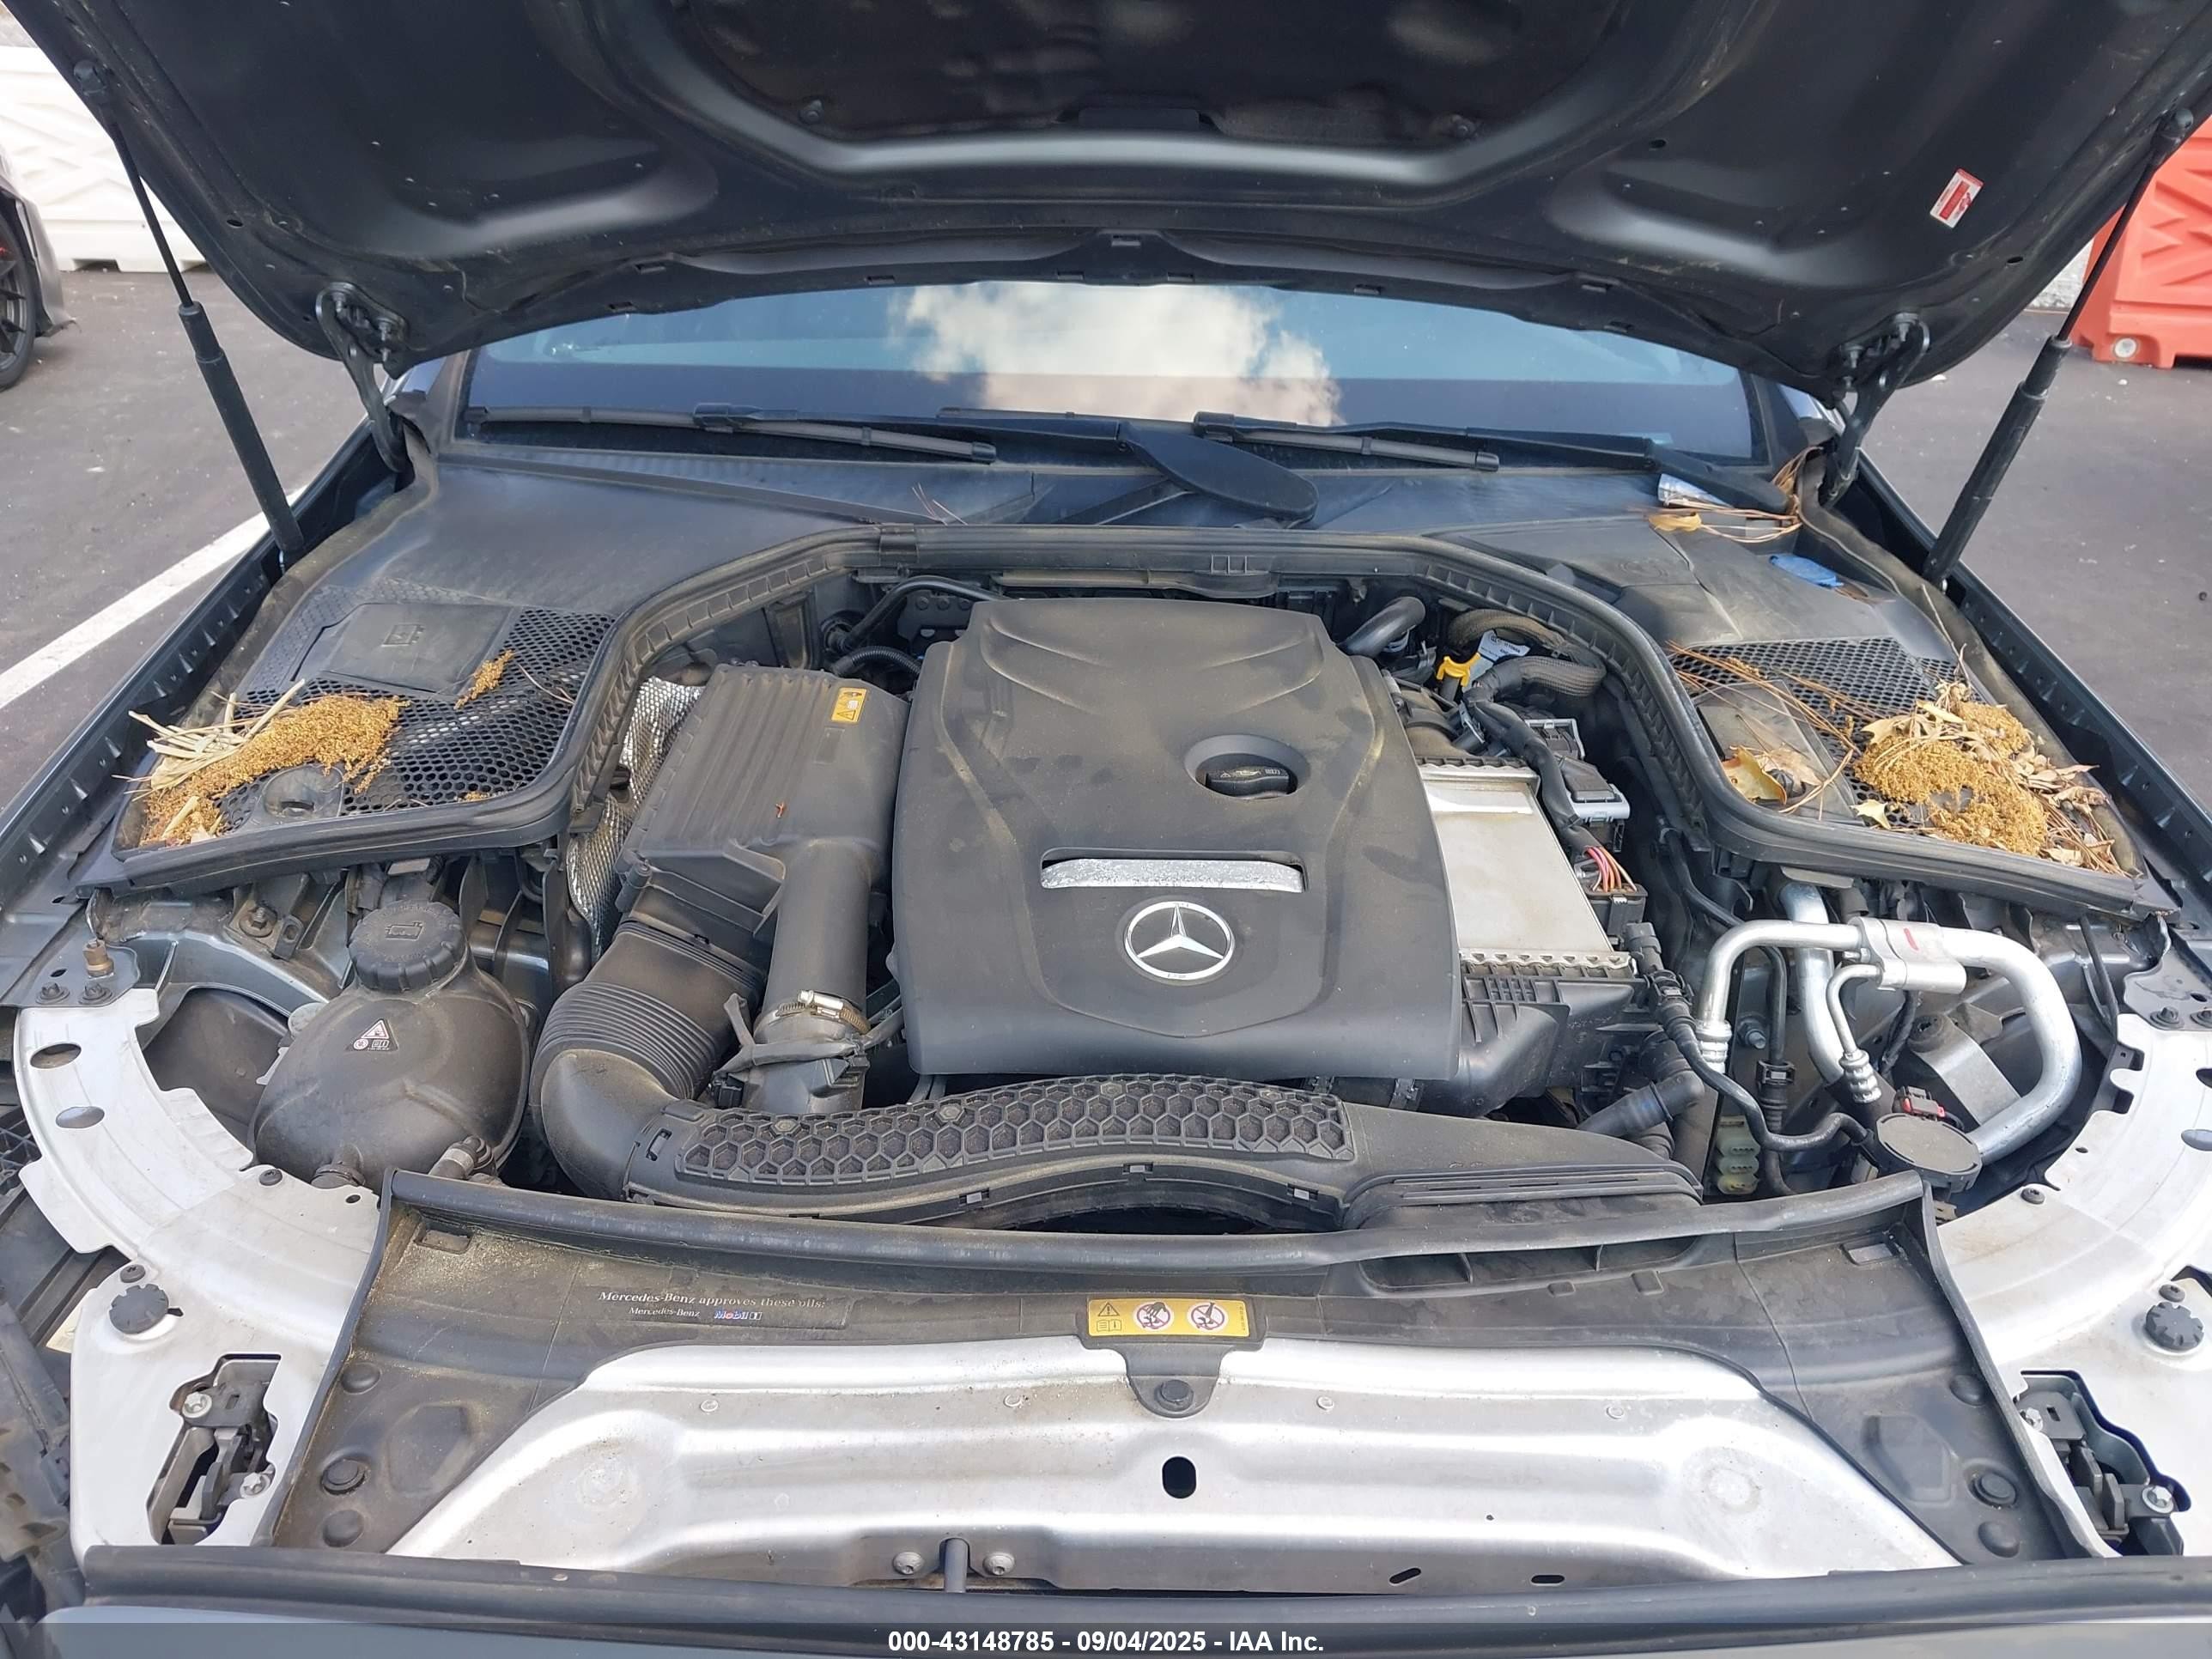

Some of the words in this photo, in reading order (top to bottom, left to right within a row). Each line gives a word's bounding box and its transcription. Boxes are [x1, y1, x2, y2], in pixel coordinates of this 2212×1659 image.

[599, 1291, 696, 1304] Mercedes-Benz
[699, 1297, 757, 1306] approves
[761, 1297, 795, 1307] these
[628, 1307, 701, 1317] Mercedes-Benz
[714, 1310, 750, 1320] Mobil
